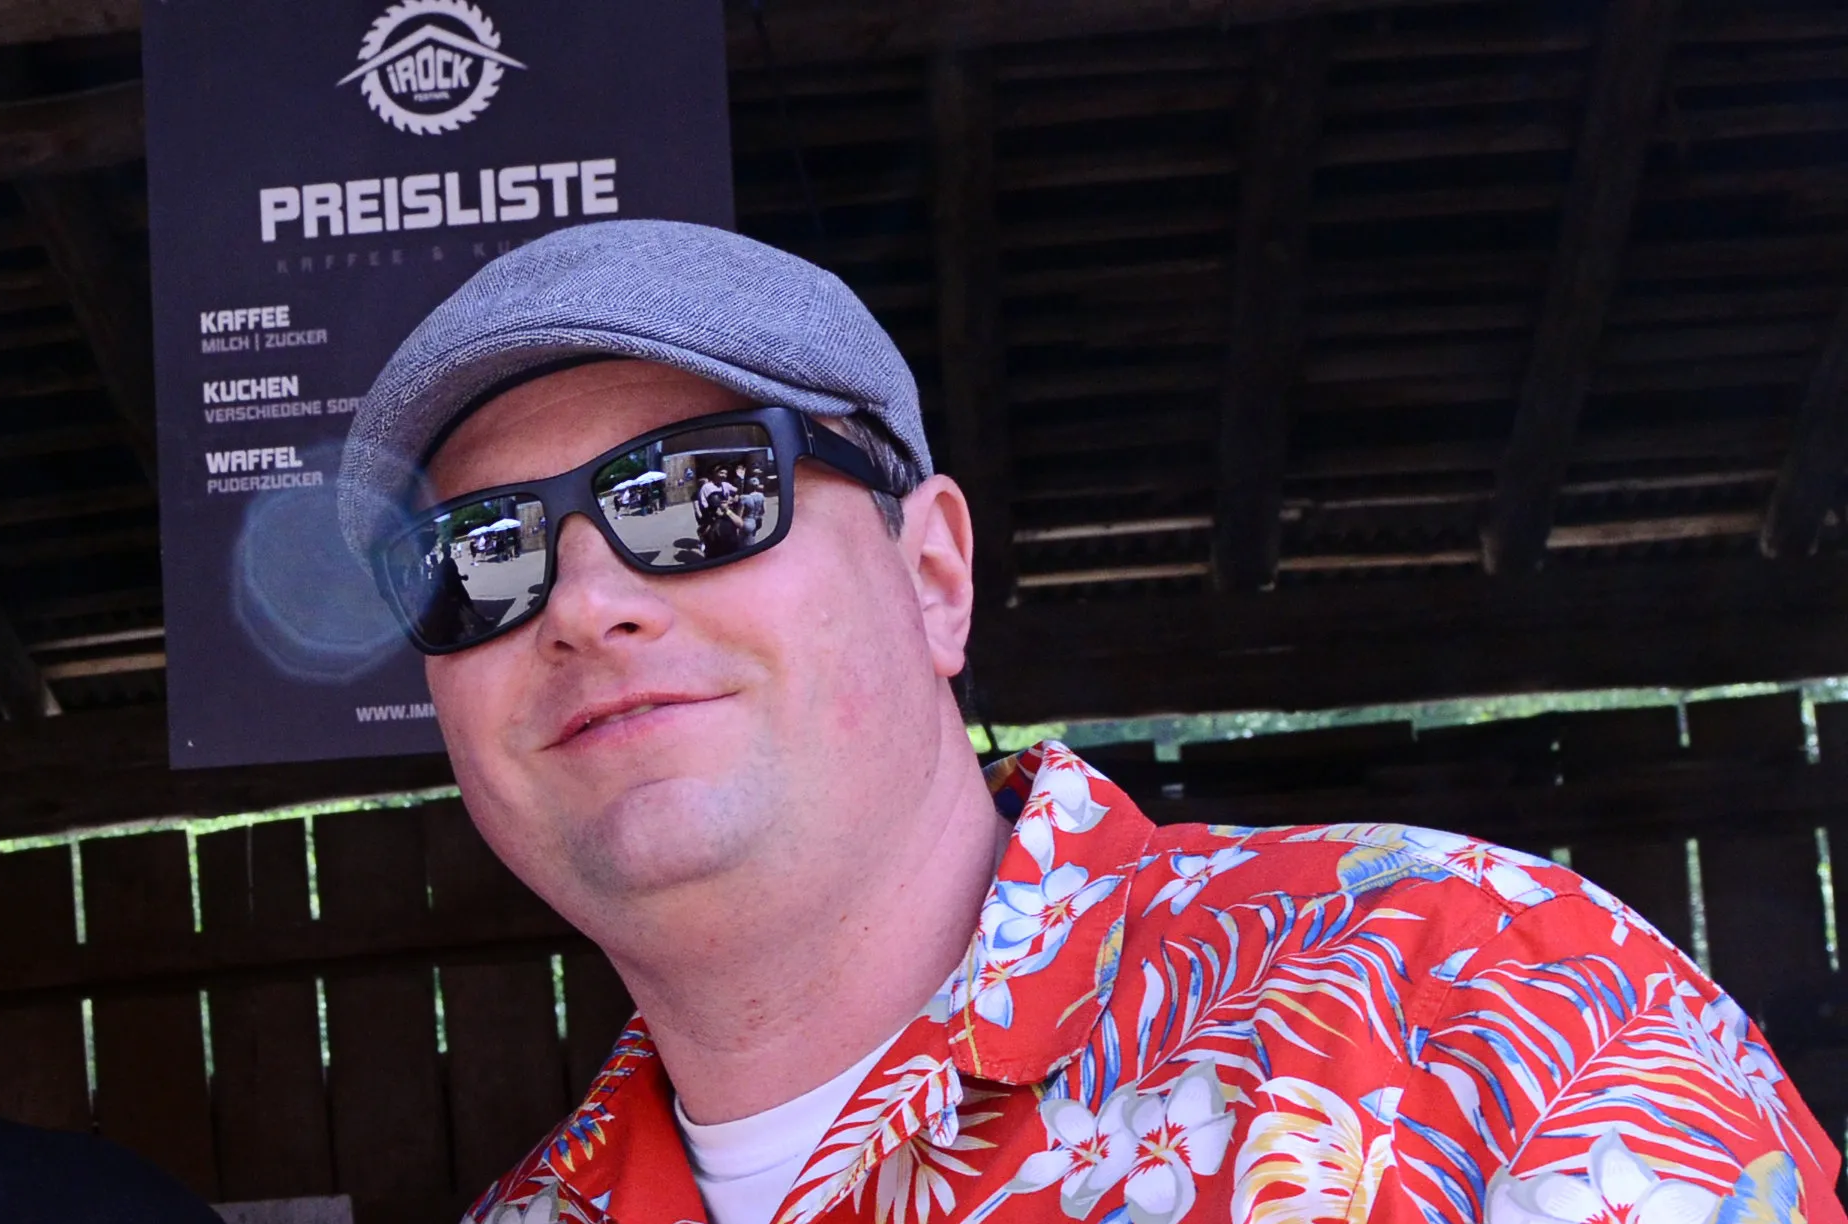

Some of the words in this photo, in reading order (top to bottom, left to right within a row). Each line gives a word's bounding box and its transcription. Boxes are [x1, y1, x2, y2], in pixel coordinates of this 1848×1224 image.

[386, 45, 474, 95] iROCK
[260, 158, 618, 242] PREISLISTE
[200, 305, 290, 334] KAFFEE
[201, 335, 250, 354] MILCH
[264, 328, 328, 349] ZUCKER
[203, 375, 299, 404] KUCHEN
[204, 399, 323, 424] VERSCHIEDENE
[205, 446, 303, 474] WAFFEL
[207, 470, 323, 494] PUDERZUCKER
